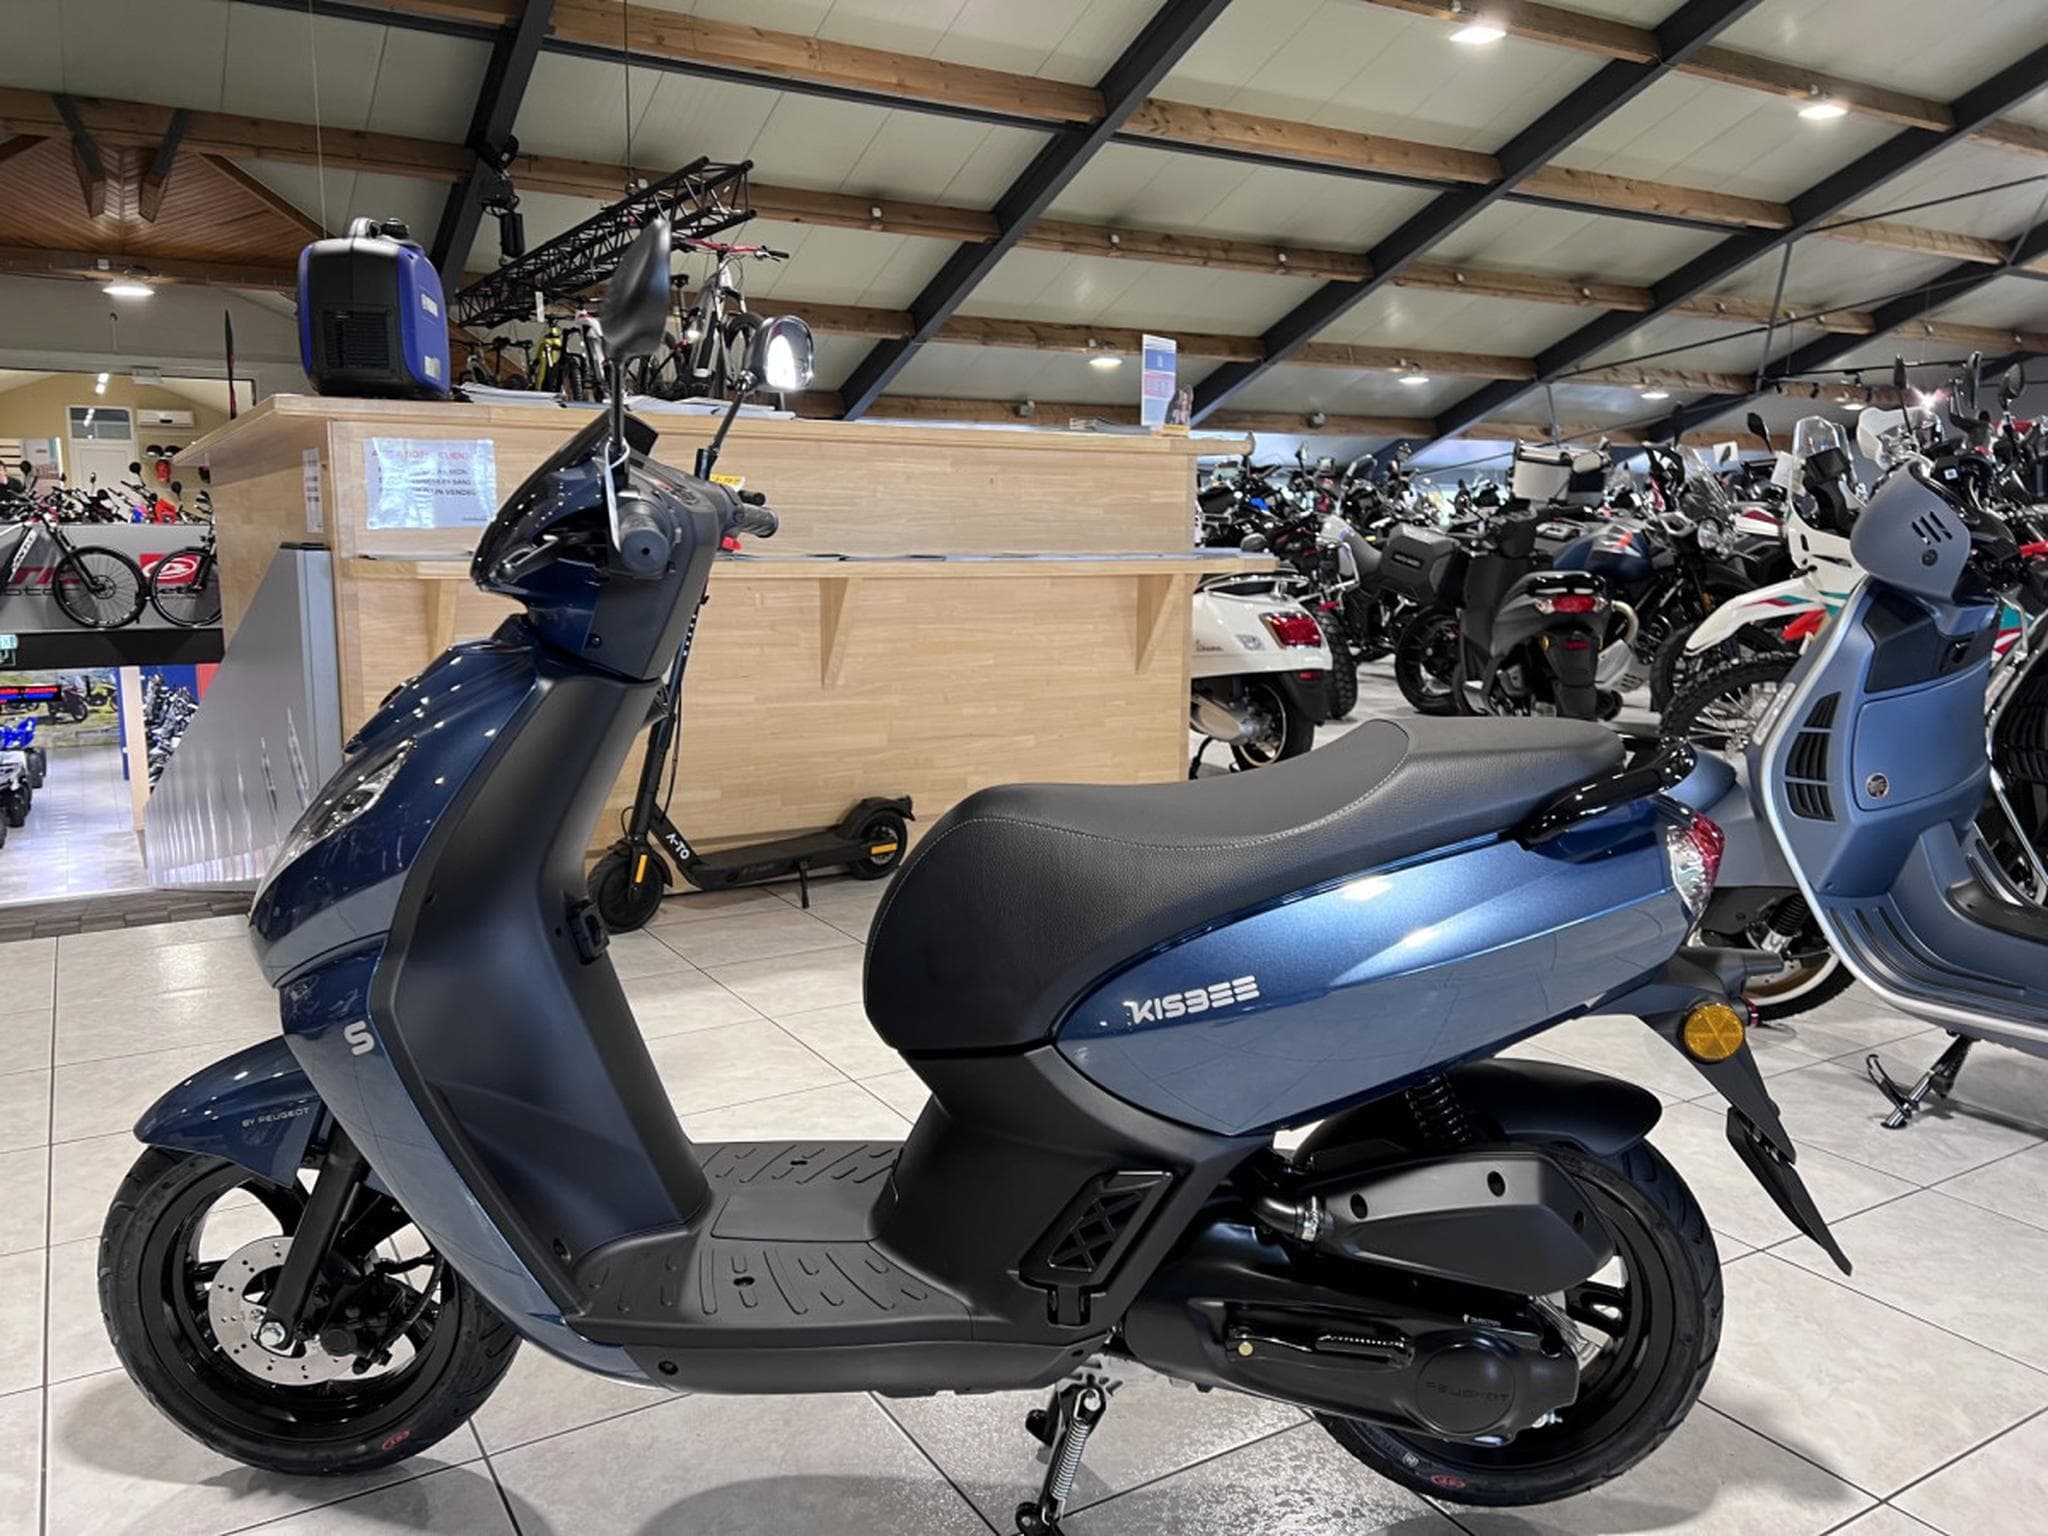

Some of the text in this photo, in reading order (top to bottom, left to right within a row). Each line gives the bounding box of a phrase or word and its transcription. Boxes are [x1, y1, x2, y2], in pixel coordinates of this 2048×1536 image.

[1128, 974, 1260, 1025] KISBEE
[343, 1020, 375, 1055] S
[241, 1106, 310, 1128] BY PEUGEOT
